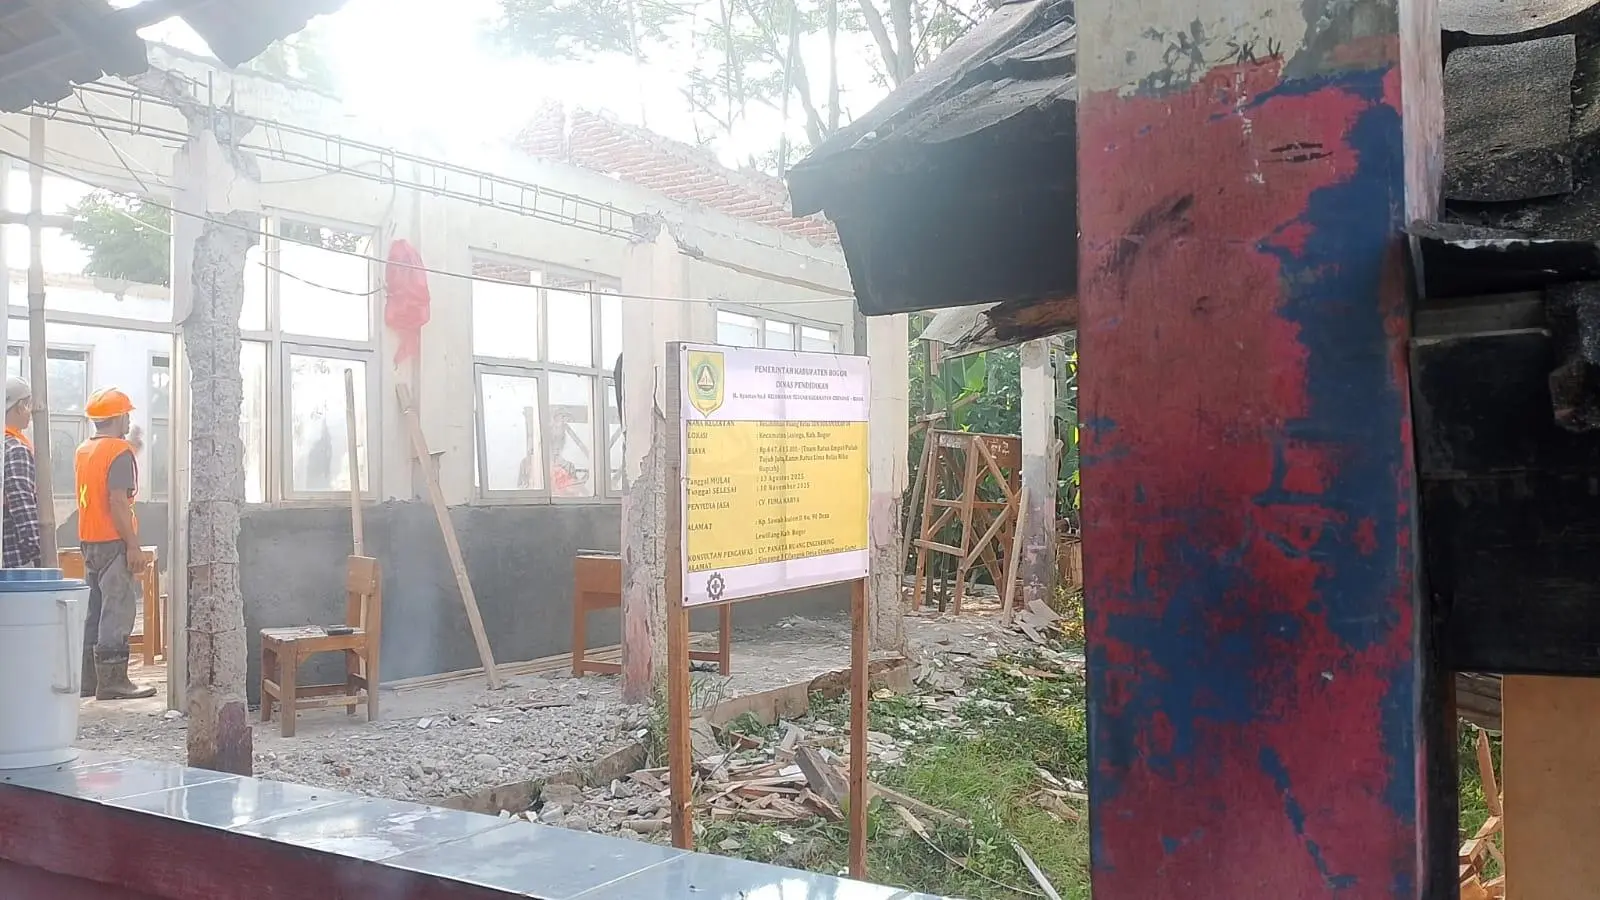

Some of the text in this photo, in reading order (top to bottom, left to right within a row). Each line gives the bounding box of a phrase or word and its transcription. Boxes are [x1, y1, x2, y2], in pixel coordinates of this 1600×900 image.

[754, 365, 847, 377] PEMERINTAH KABUPATEN BOGOR
[776, 380, 828, 390] DINAS PENDIDIKAN
[817, 431, 831, 439] Bogor
[712, 486, 737, 495] SELESAI
[769, 483, 796, 491] November
[688, 501, 730, 510] PENYEDIA JASA
[688, 551, 722, 562] KONSULTAN
[724, 548, 754, 558] PENGAWAS
[688, 563, 712, 571] ALAMAT
